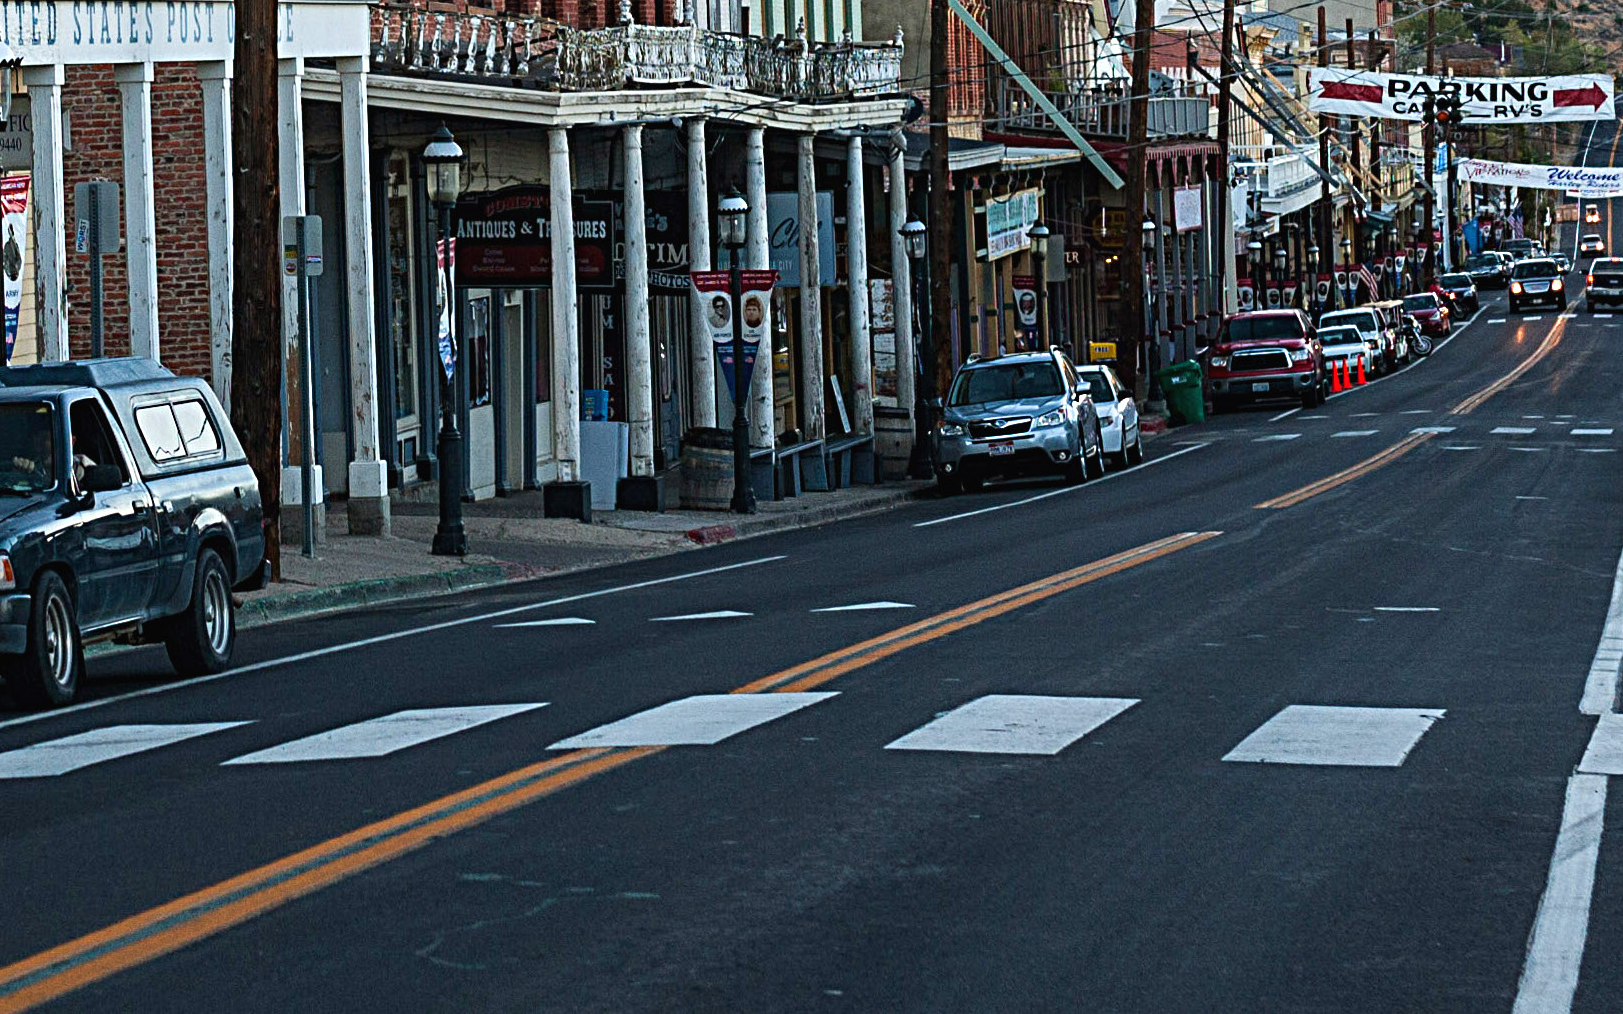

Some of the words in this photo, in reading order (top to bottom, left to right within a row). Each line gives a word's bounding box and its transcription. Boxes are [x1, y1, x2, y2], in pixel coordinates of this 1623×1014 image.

[73, 1, 154, 45] STATES
[167, 1, 214, 44] POST
[1494, 103, 1543, 119] RV'S
[0, 137, 22, 151] 9440
[1546, 167, 1620, 181] Welcome
[457, 217, 516, 238] ANTIQUES
[520, 222, 533, 235] &
[648, 272, 690, 288] HOTOS
